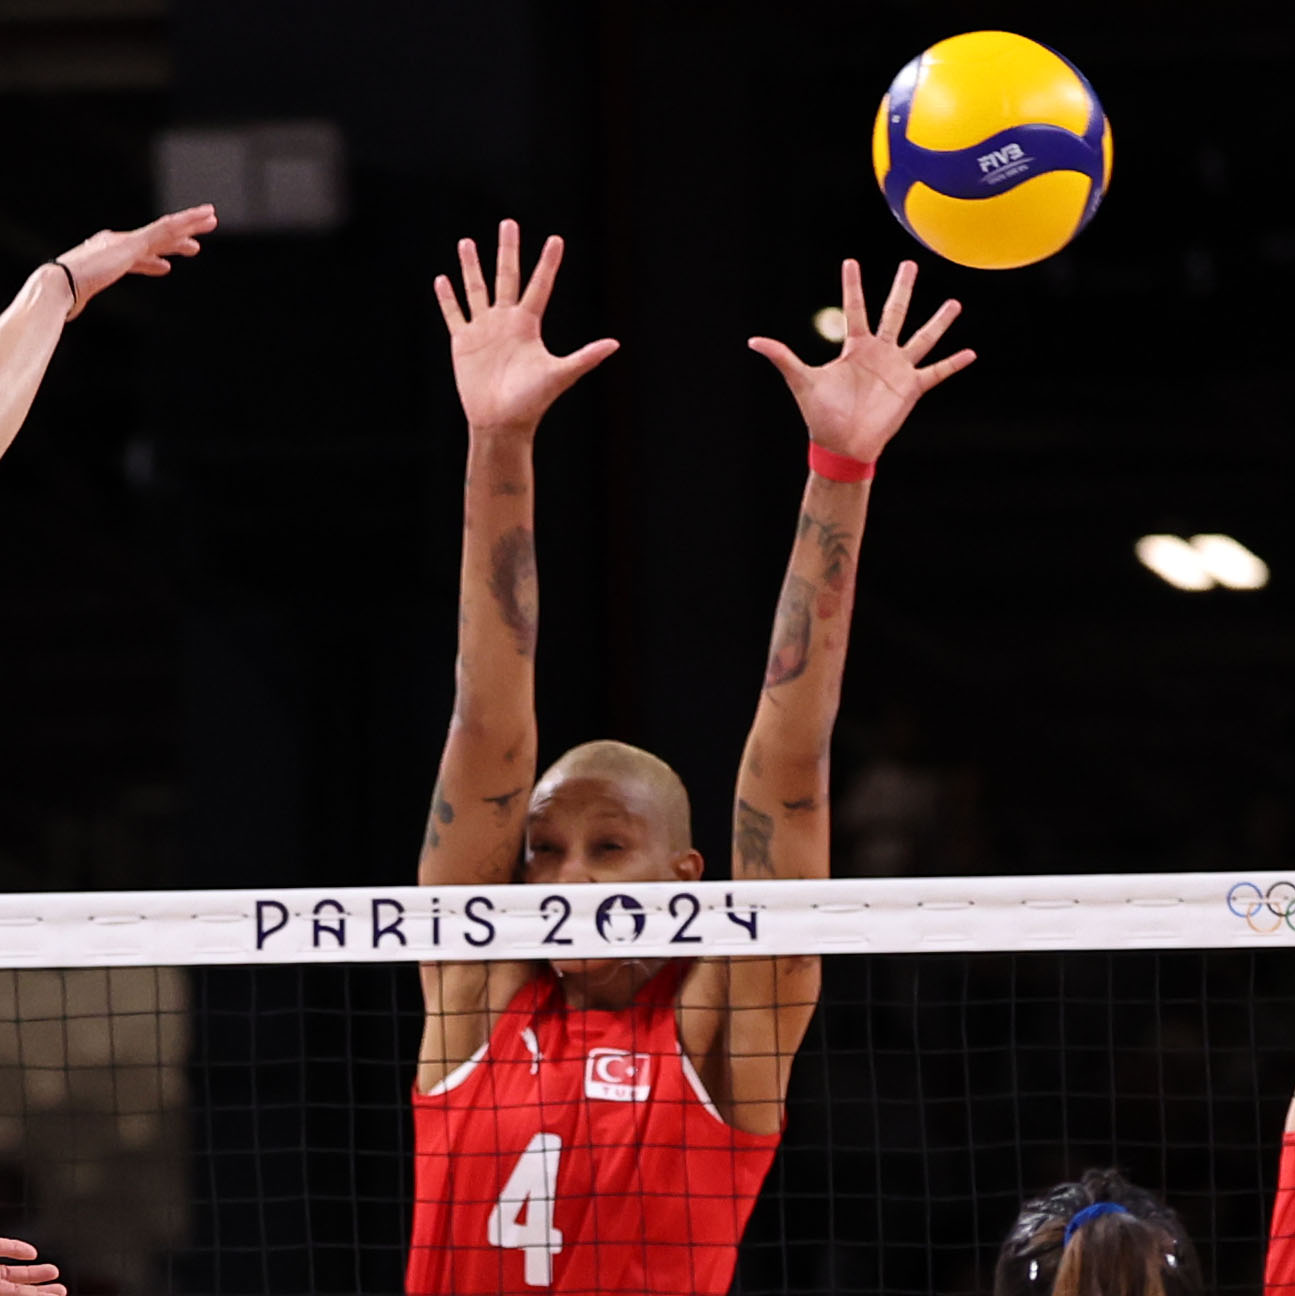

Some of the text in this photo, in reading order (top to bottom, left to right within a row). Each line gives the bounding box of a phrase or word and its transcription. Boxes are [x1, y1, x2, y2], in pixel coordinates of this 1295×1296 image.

[977, 143, 1024, 173] FIVB
[539, 893, 758, 945] 2024
[488, 1132, 562, 1287] 4
